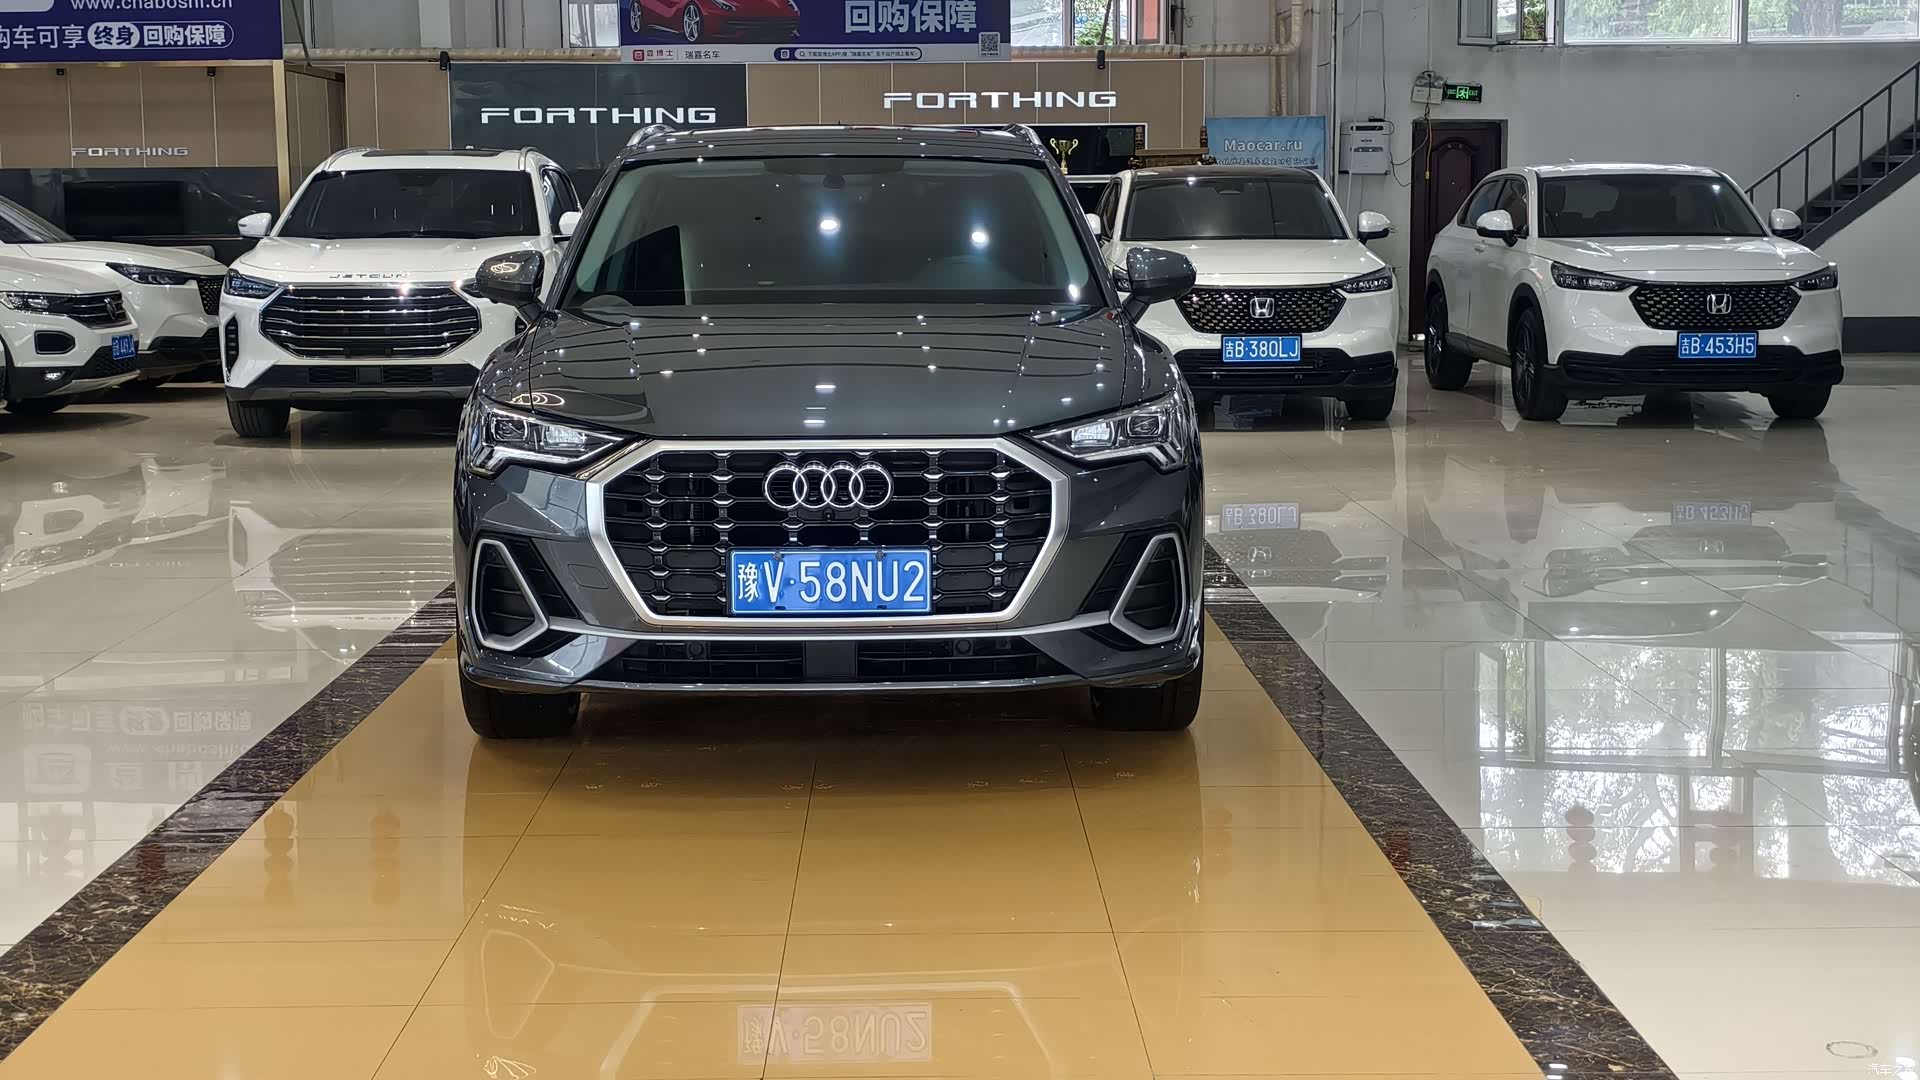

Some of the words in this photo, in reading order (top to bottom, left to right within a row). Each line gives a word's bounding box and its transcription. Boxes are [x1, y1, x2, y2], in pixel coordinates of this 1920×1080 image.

[845, 0, 977, 33] 回购保障
[94, 26, 135, 46] 终身
[143, 25, 226, 46] 回购保障
[883, 91, 1117, 109] FORTHING
[480, 107, 717, 125] FORTHING
[71, 147, 189, 156] FORTHING
[1224, 139, 1303, 152] Maocar.ru
